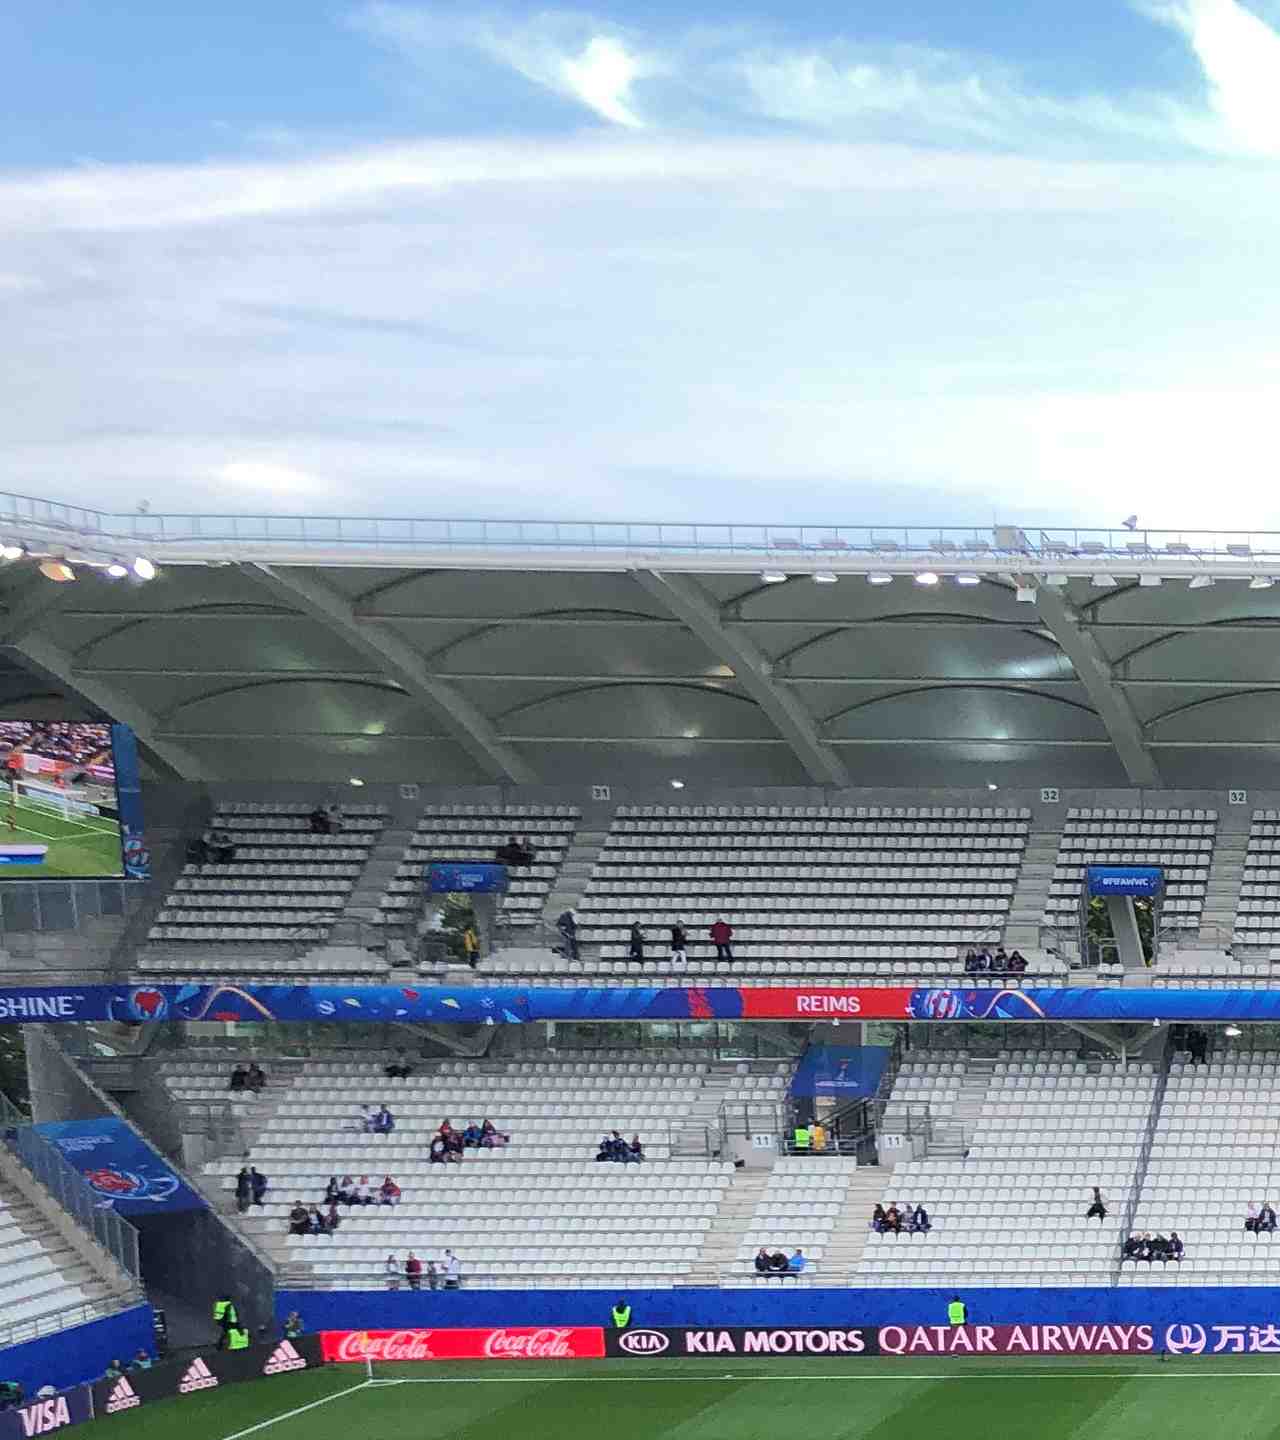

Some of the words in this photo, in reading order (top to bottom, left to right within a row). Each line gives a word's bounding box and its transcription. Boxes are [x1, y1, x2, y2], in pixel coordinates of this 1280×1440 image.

[1043, 790, 1057, 800] 32
[1231, 792, 1245, 801] 32
[797, 995, 861, 1013] REIMS
[887, 1136, 900, 1145] 11
[339, 1331, 432, 1361] Coca-Cola
[484, 1328, 574, 1359] Coca-Cola
[628, 1335, 661, 1349] KIA
[686, 1331, 736, 1352] KIA
[743, 1331, 865, 1352] MOTORS
[880, 1326, 998, 1354] QATAR
[1009, 1325, 1154, 1352] AIRWAYS
[17, 1397, 71, 1437] VISA
